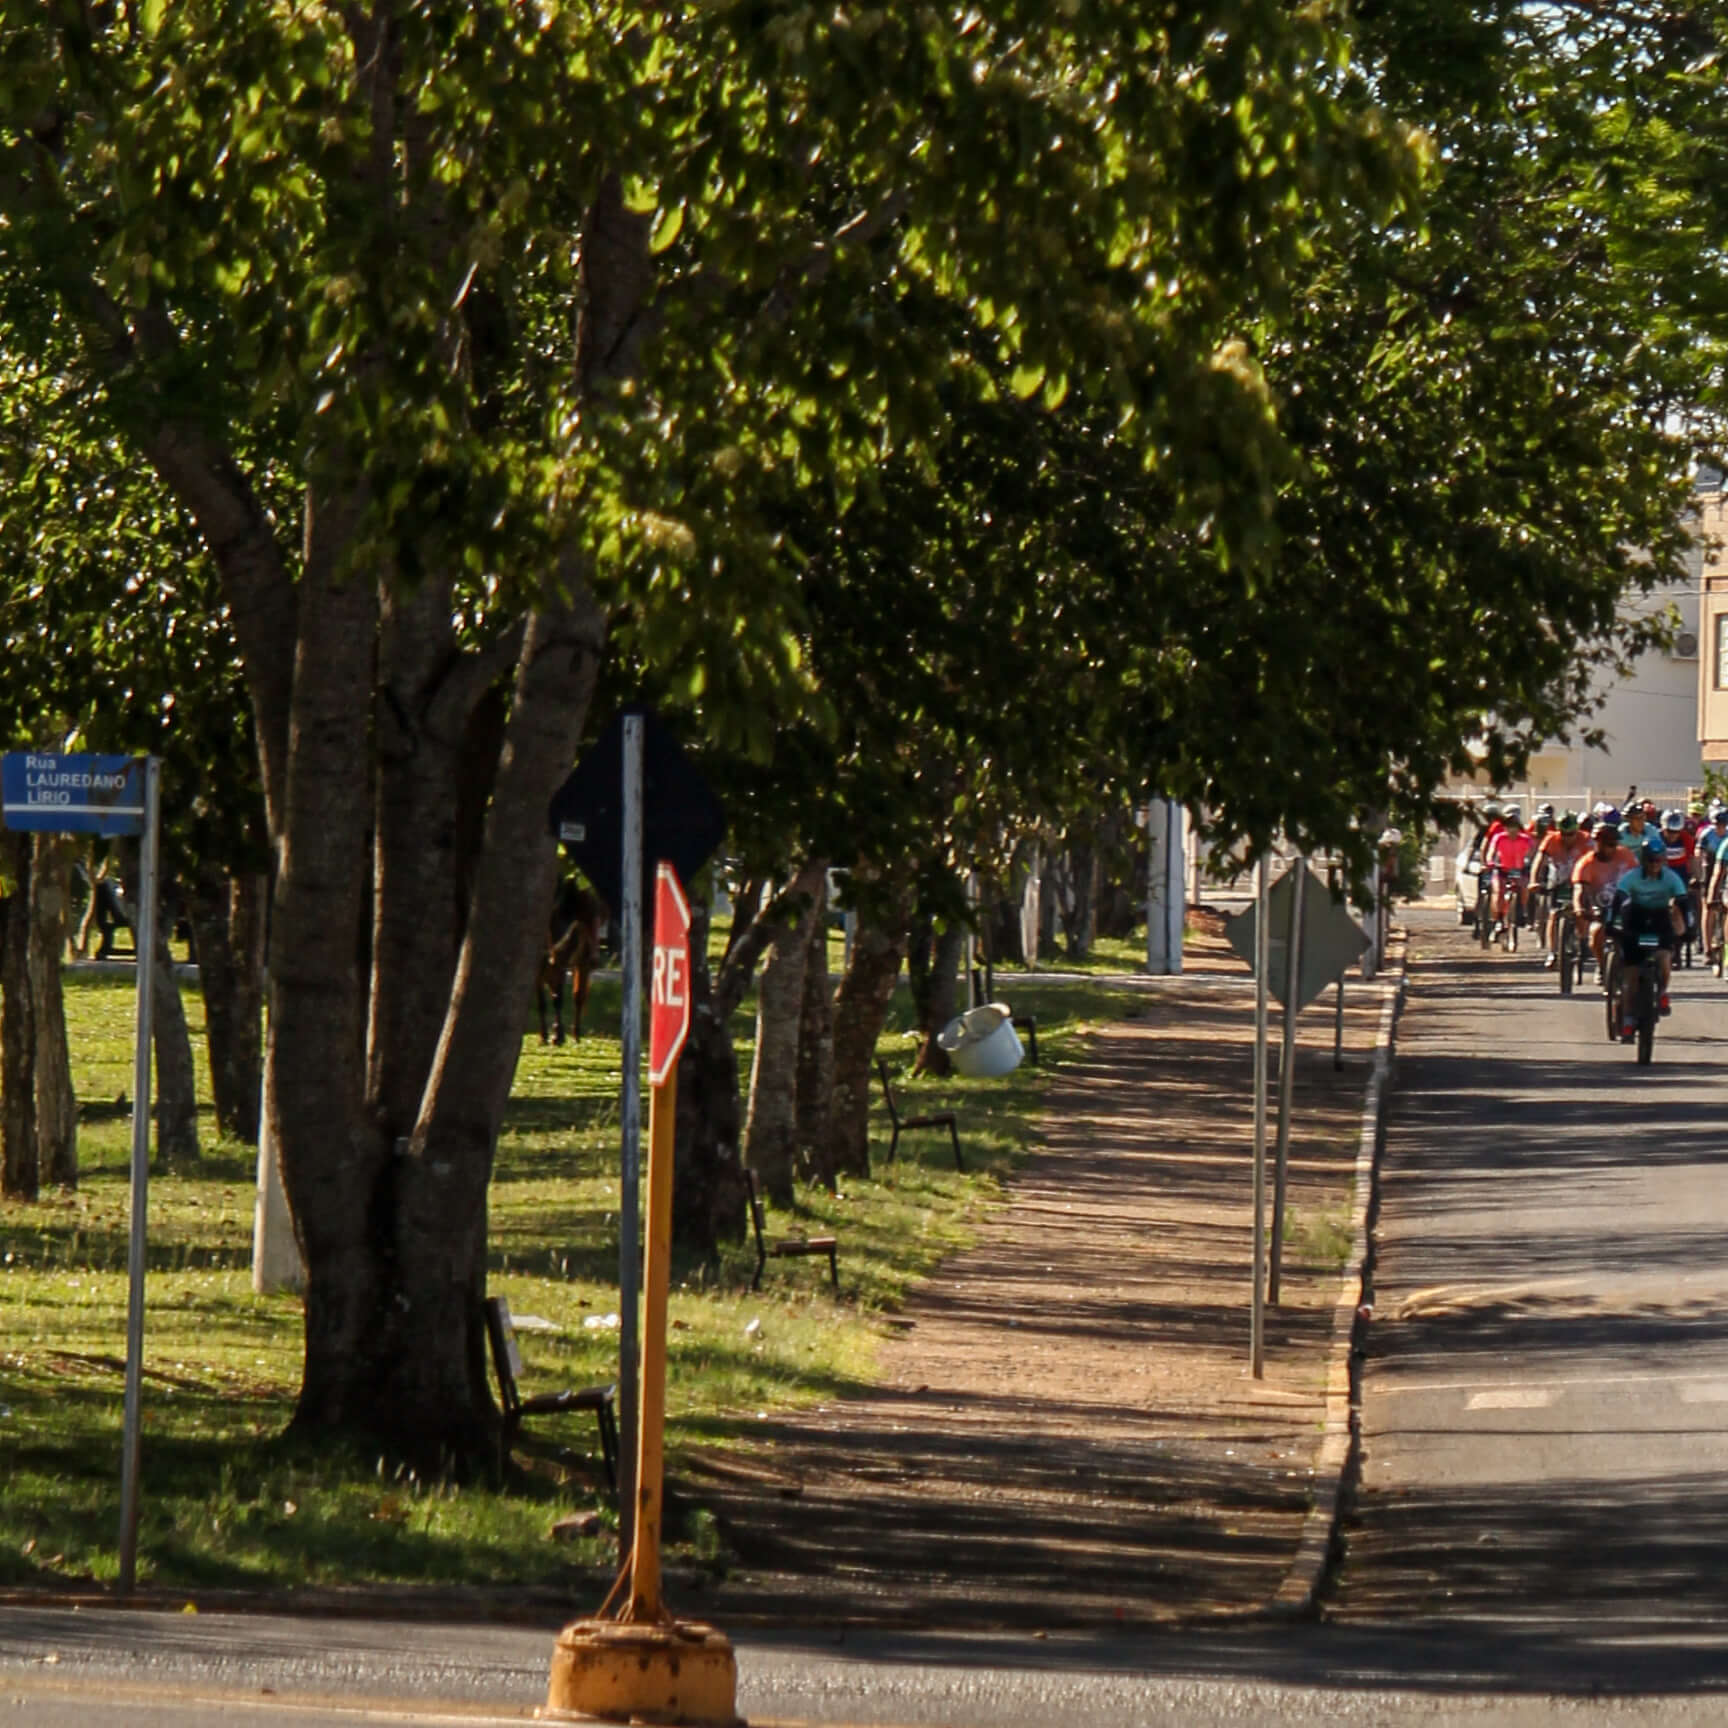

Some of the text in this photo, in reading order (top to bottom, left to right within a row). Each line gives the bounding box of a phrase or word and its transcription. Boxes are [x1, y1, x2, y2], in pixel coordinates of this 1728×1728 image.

[26, 755, 56, 769] Rua
[27, 773, 126, 789] LAUREDANO
[652, 946, 686, 1006] RE
